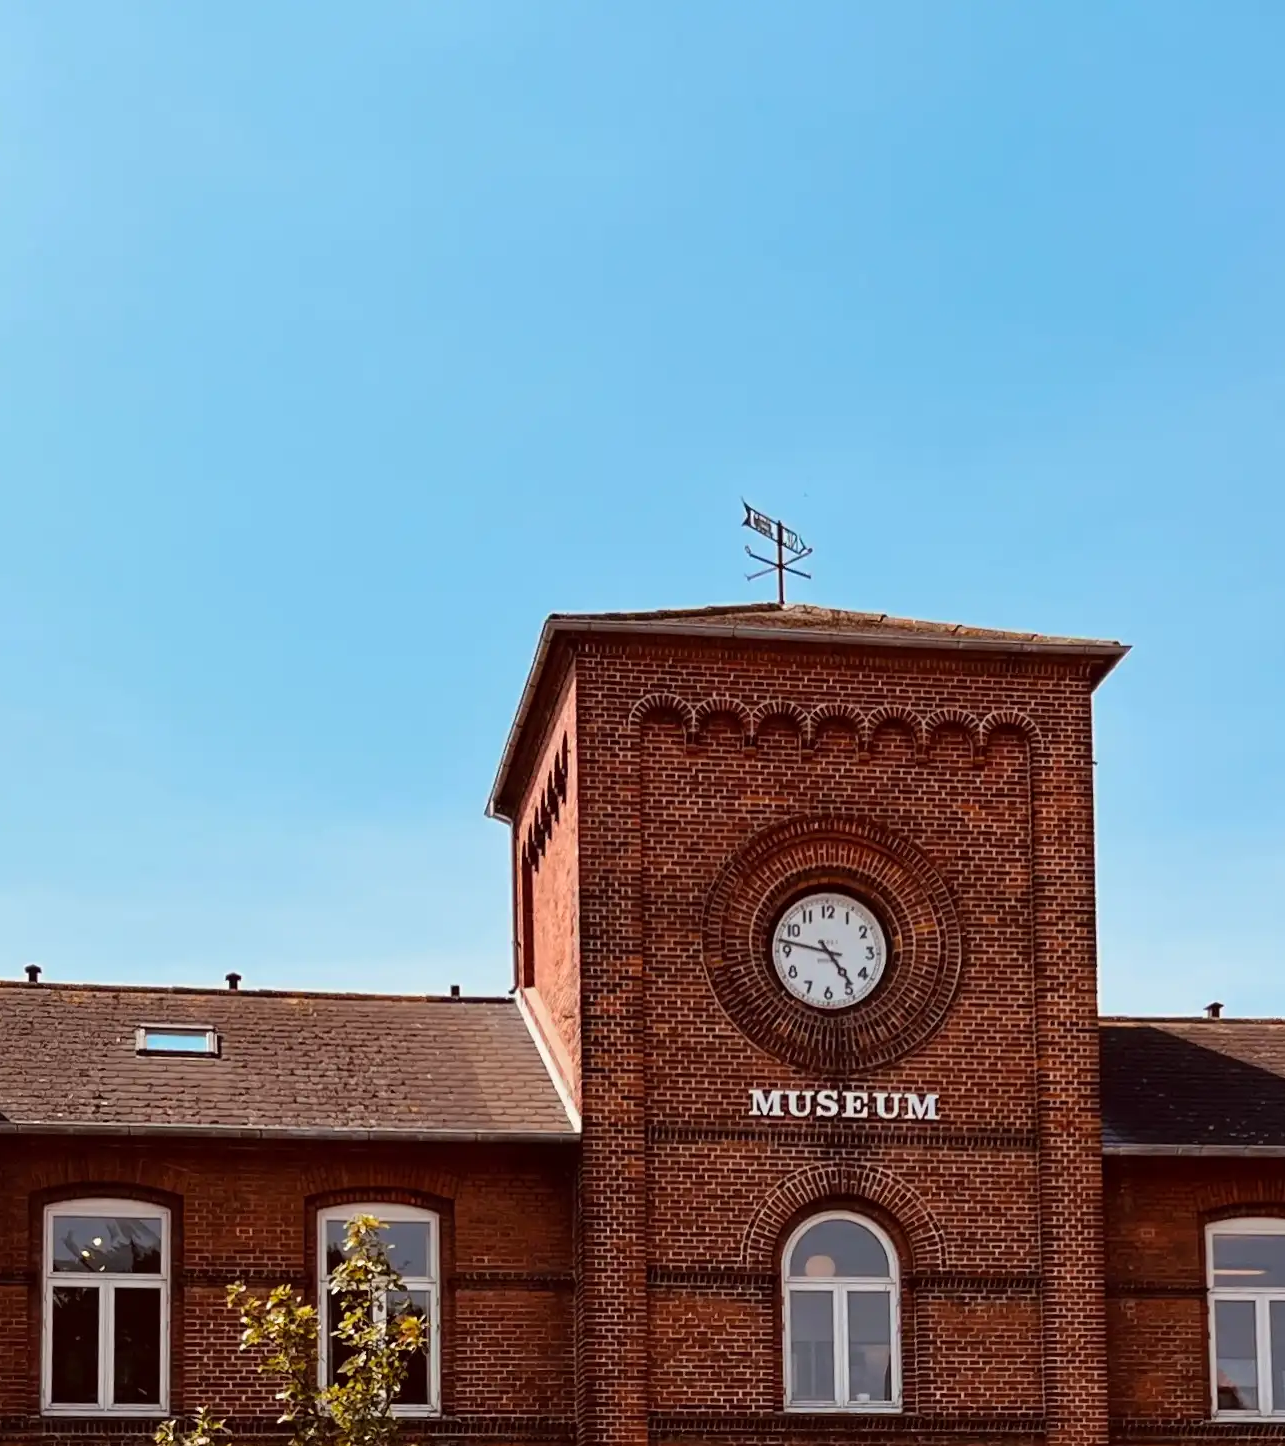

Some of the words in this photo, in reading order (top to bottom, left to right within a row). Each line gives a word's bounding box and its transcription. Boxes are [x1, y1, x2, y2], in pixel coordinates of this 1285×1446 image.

[802, 910, 813, 924] 11
[821, 905, 835, 919] 12
[845, 911, 850, 925] 1
[787, 924, 801, 938] 10
[858, 925, 868, 939] 2
[782, 944, 792, 958] 9
[865, 946, 875, 960] 3
[788, 965, 798, 979] 8
[857, 967, 869, 981] 4
[804, 980, 813, 994] 7
[824, 986, 833, 1000] 6
[845, 981, 854, 996] 5
[748, 1089, 940, 1120] MUSEUM
